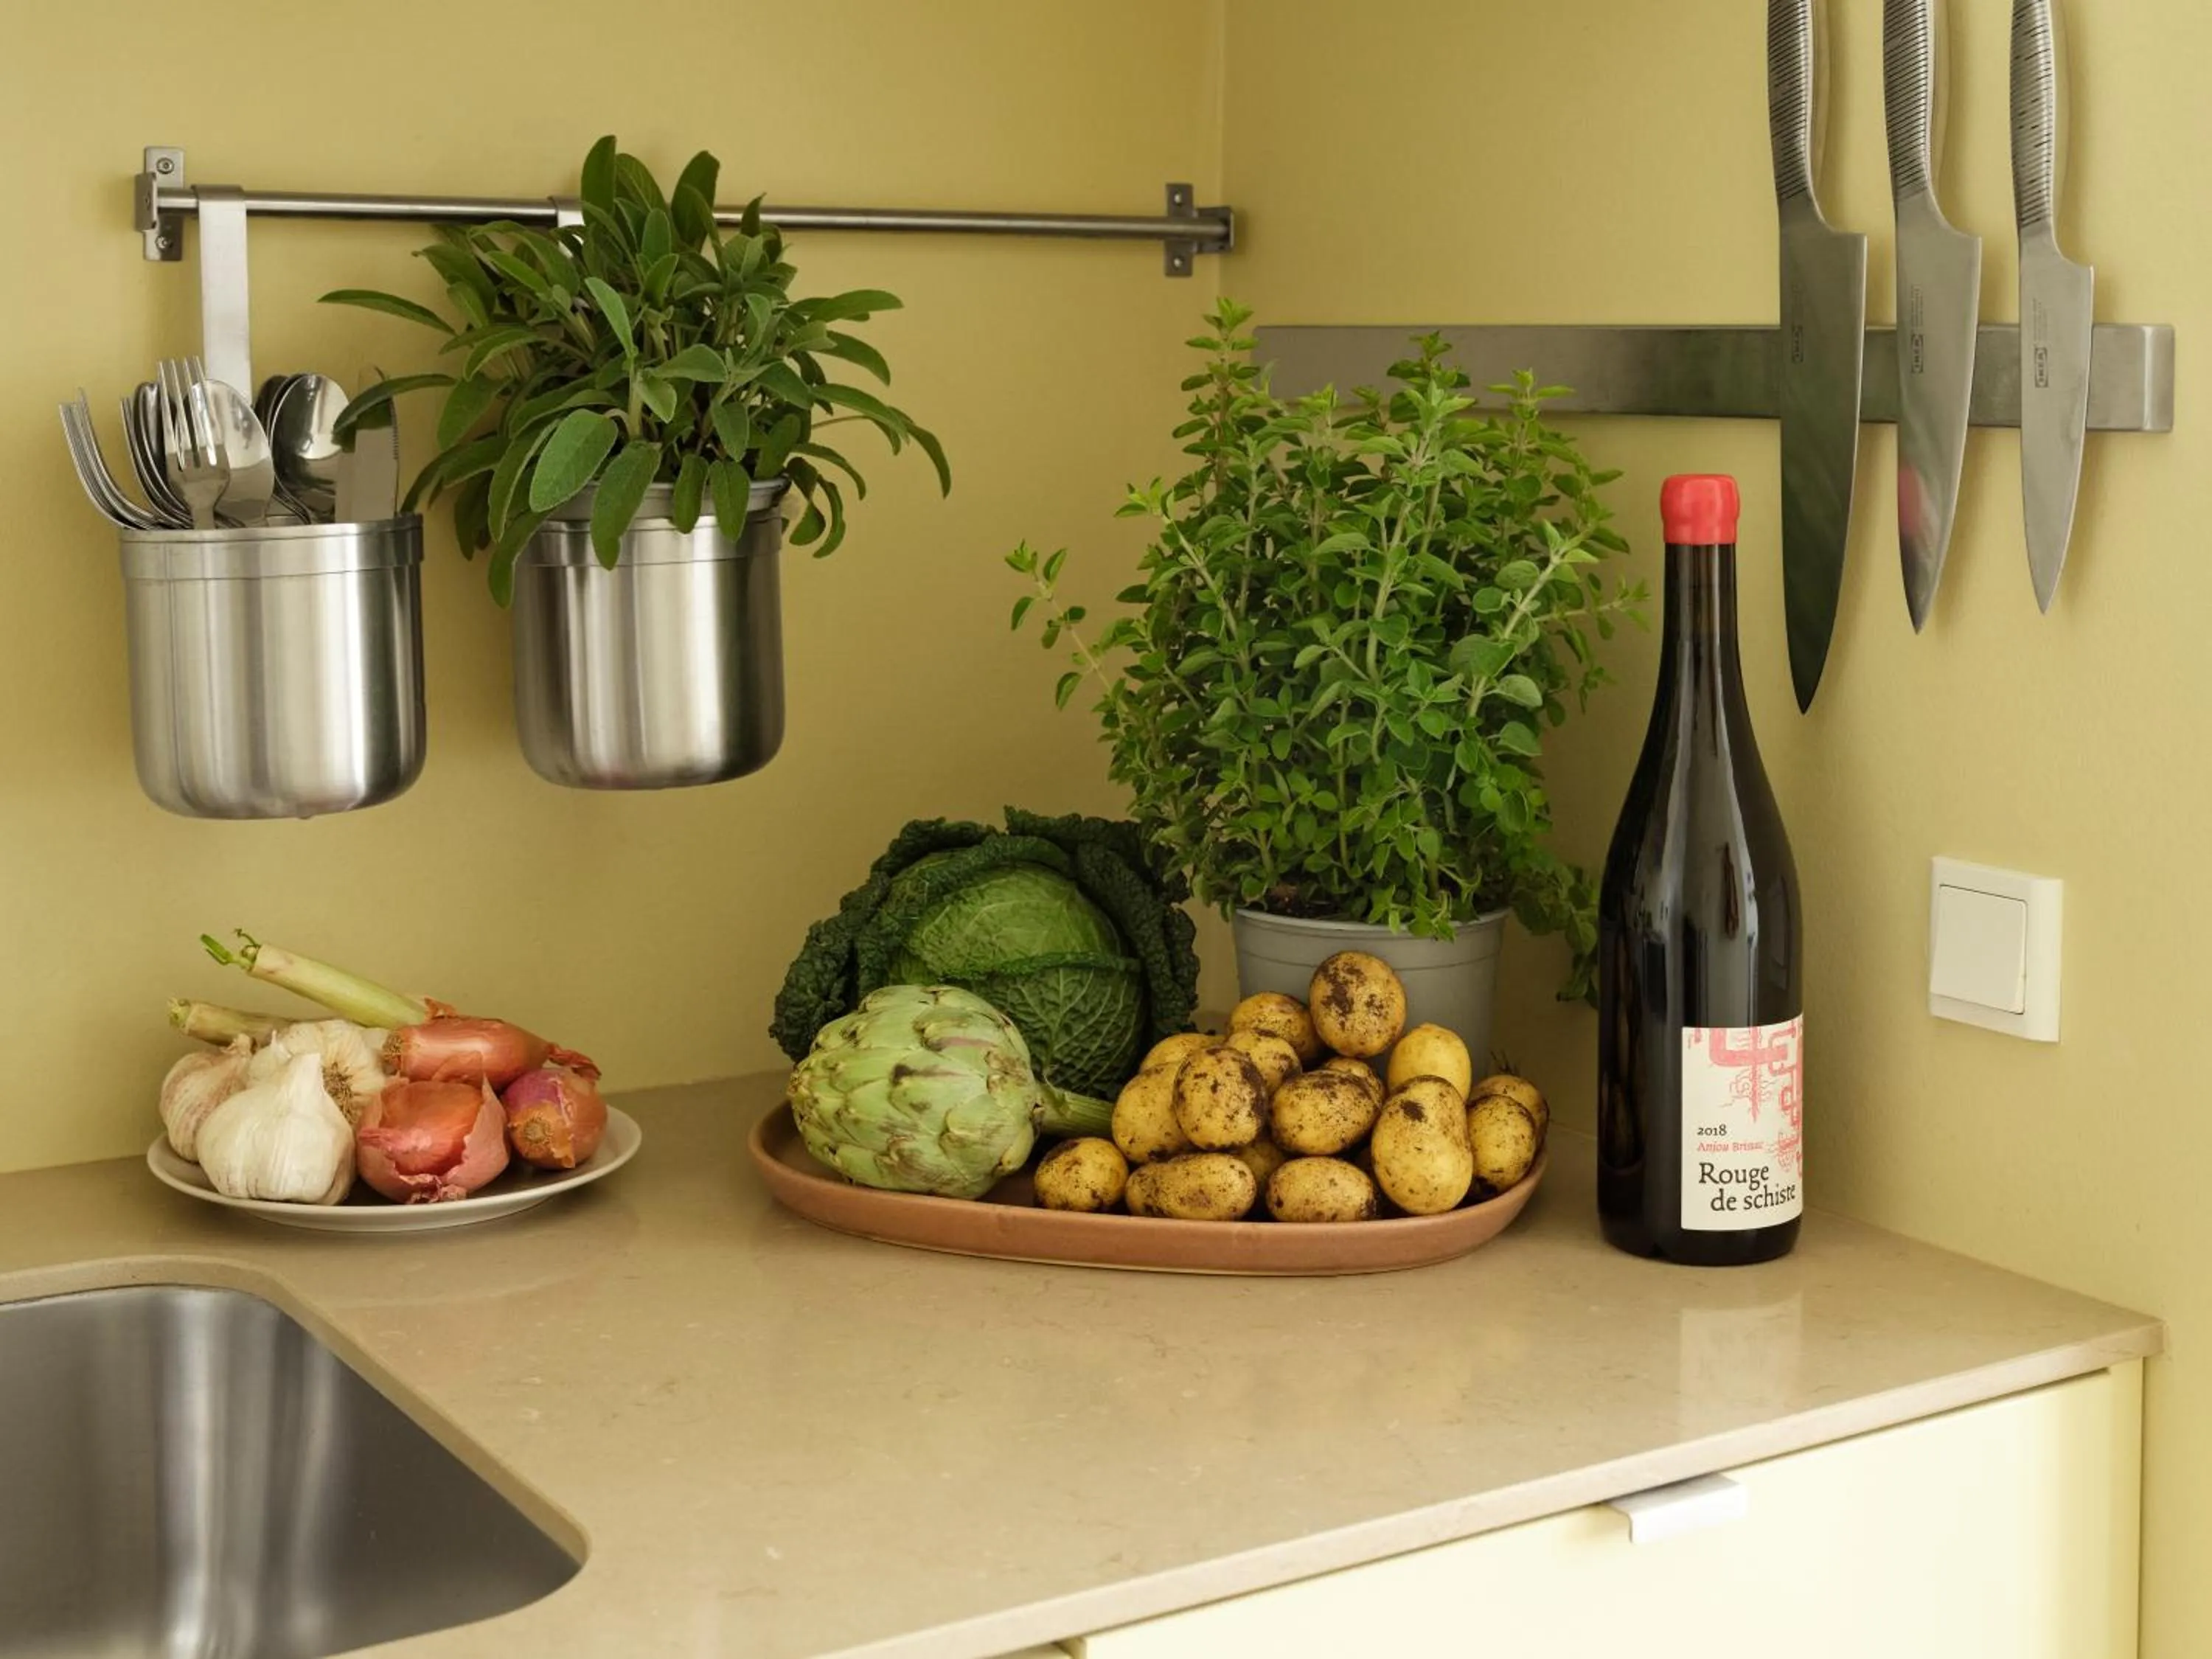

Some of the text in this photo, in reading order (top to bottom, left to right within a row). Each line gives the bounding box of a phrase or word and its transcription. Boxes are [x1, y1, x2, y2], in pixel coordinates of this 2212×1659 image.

[1697, 1124, 1727, 1136] 2018
[1699, 1162, 1769, 1191] Rouge
[1711, 1183, 1795, 1211] de schiste
